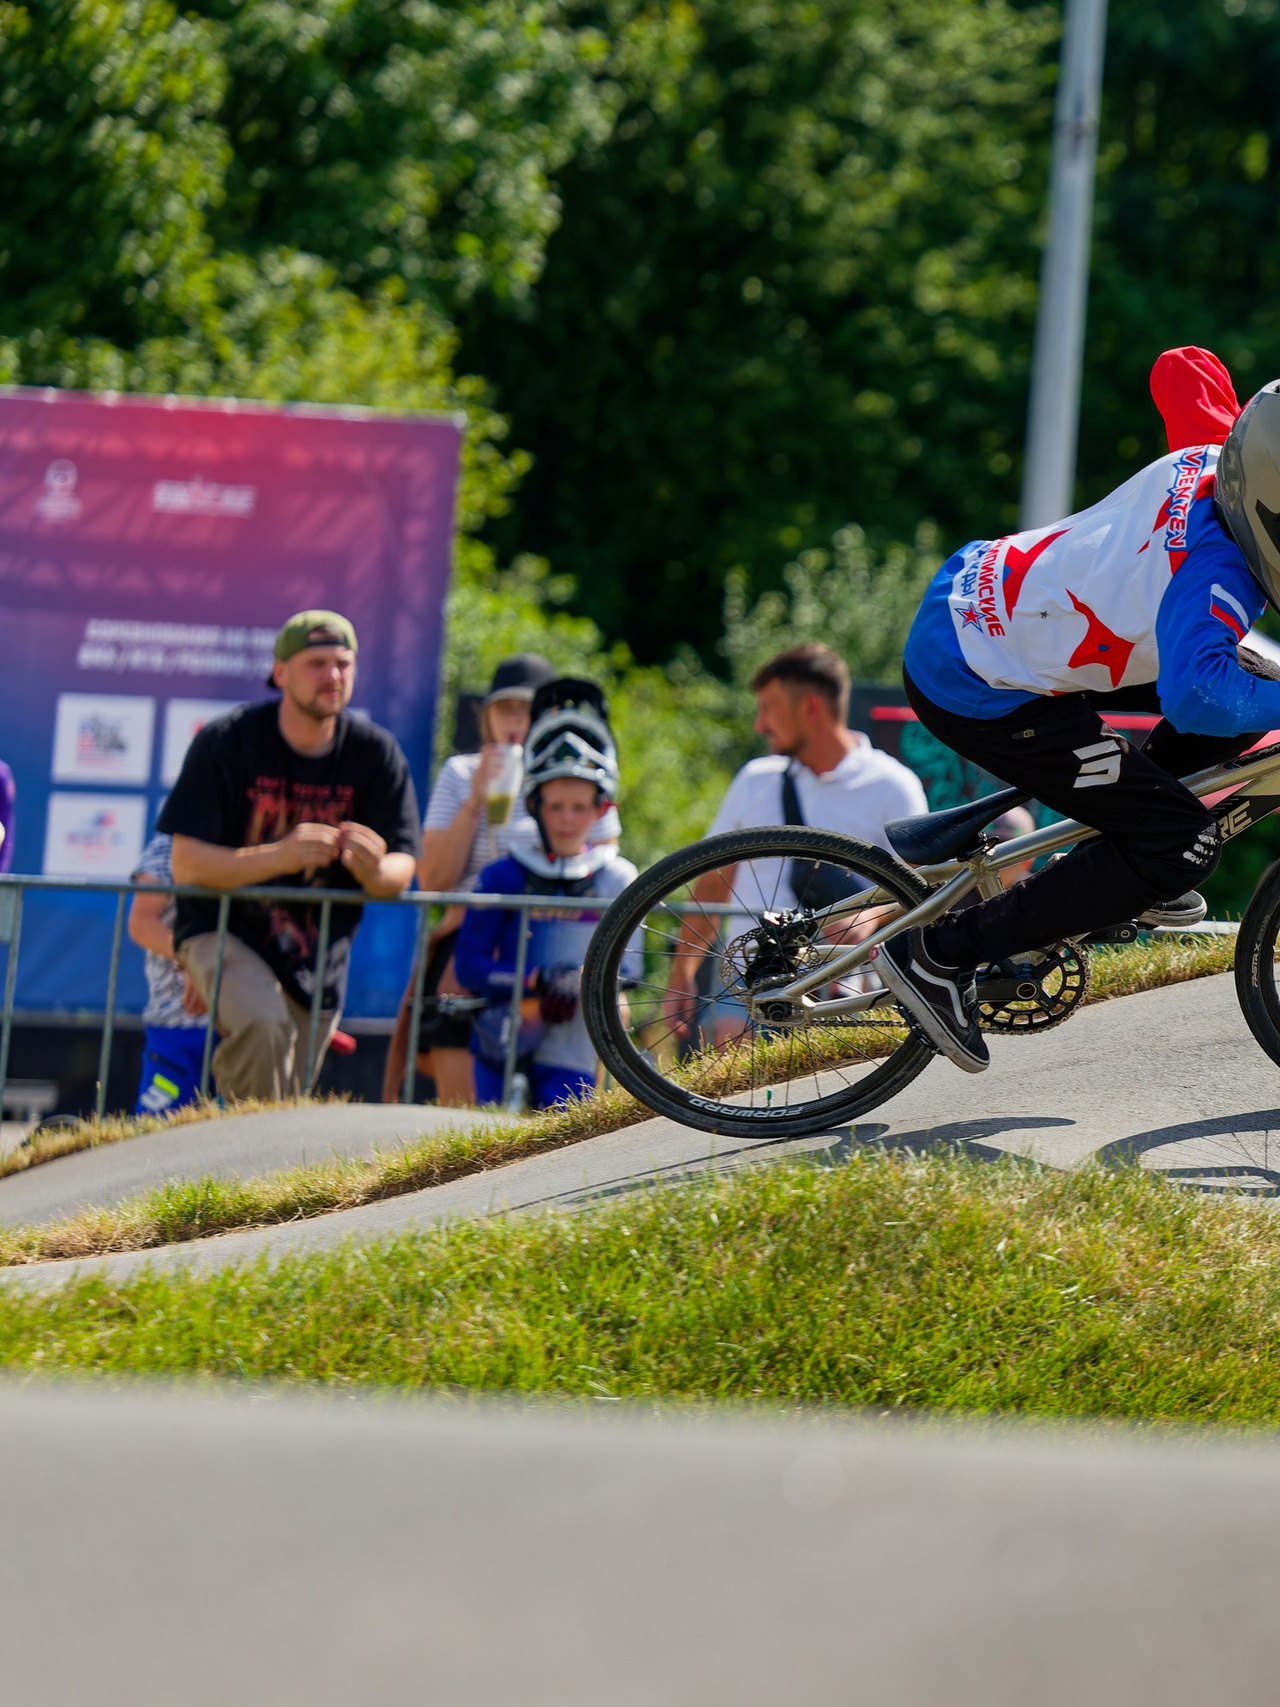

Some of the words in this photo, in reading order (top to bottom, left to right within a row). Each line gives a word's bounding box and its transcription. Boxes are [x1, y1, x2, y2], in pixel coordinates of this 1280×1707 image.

[1166, 444, 1207, 548] VRENTEV
[978, 540, 1006, 637] МПИЙСКИЕ
[1218, 800, 1252, 840] RE
[1253, 942, 1261, 952] X
[1251, 953, 1259, 988] FASTR
[688, 1097, 804, 1119] FORWARD
